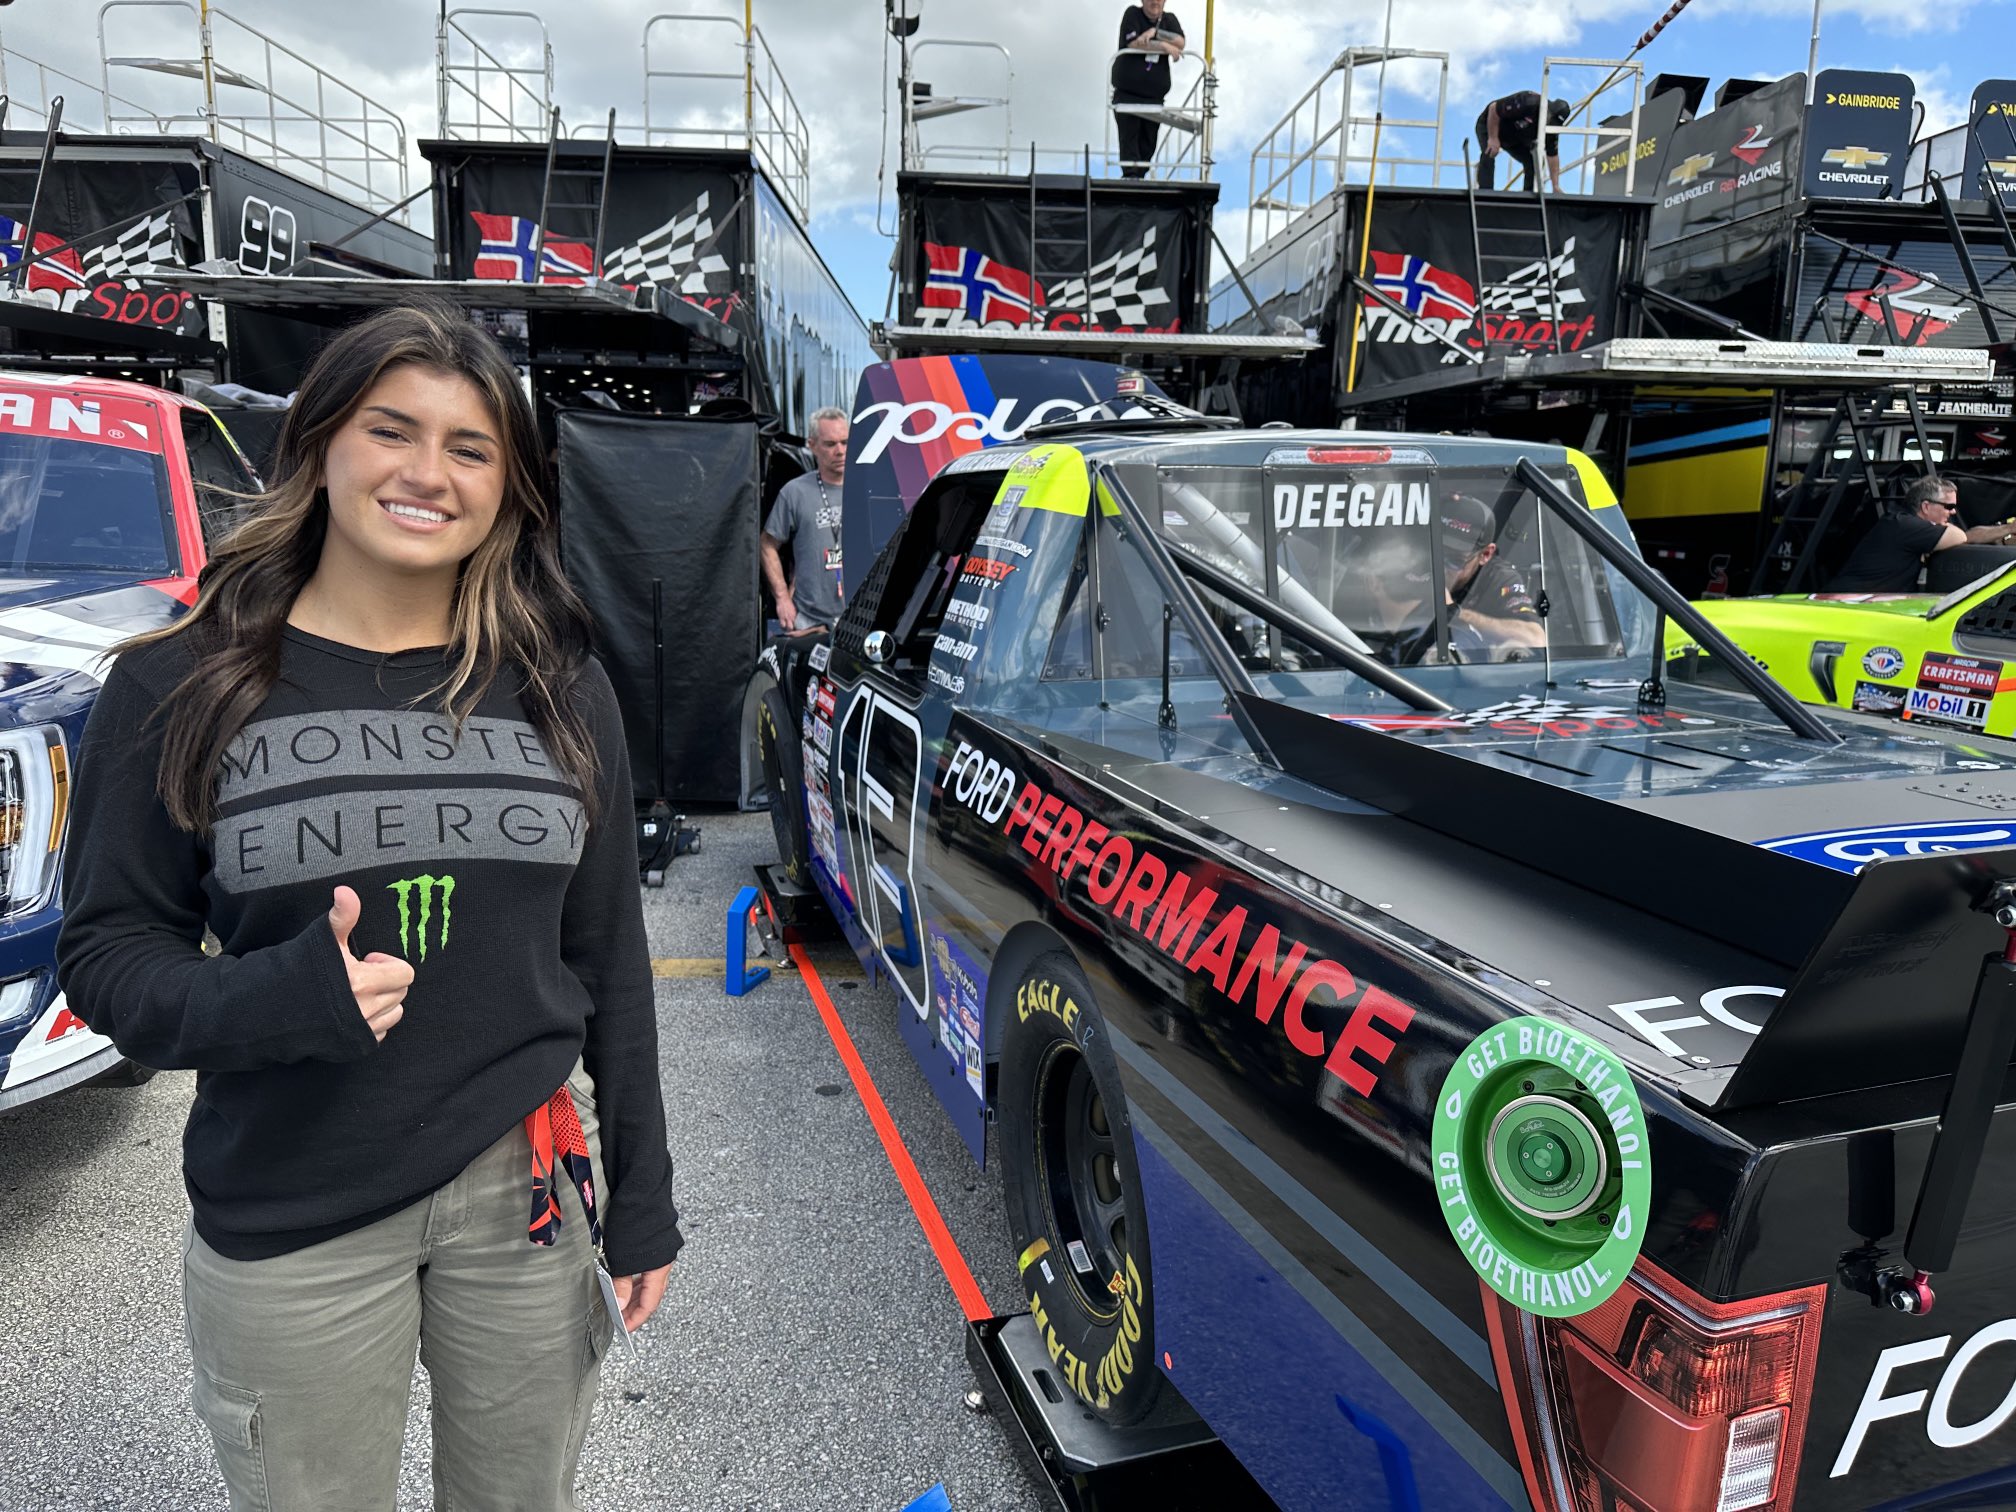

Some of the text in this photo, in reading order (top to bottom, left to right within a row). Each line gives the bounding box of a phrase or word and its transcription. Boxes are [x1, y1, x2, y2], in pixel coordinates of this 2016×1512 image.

[1838, 93, 1901, 109] GAINBRIDGE
[1609, 137, 1657, 172] GAINIDGE
[1818, 171, 1889, 185] CHEVROLET
[1663, 180, 1716, 209] CHEVROLET
[240, 196, 296, 276] 99
[1936, 402, 2013, 417] FEATHERLITE
[1273, 483, 1431, 529] DEEGAN
[960, 574, 1000, 589] BATTERY
[964, 557, 1014, 580] ODYSSEY
[948, 599, 989, 622] METHOD
[934, 634, 978, 661] can-am
[1923, 665, 1995, 687] CRAFTSMAN
[1911, 690, 1963, 715] Mobil
[220, 722, 549, 785] MONSTE
[239, 803, 584, 875] ENERGY
[941, 740, 1016, 824] FORD
[1003, 781, 1417, 1099] PERFORMANCE
[1017, 978, 1079, 1034] EAGLE
[965, 1044, 981, 1070] WIX
[1467, 1026, 1642, 1169] GET BIOETHANOL
[1438, 1151, 1469, 1208] GET
[1456, 1217, 1607, 1307] BIOETHANOL
